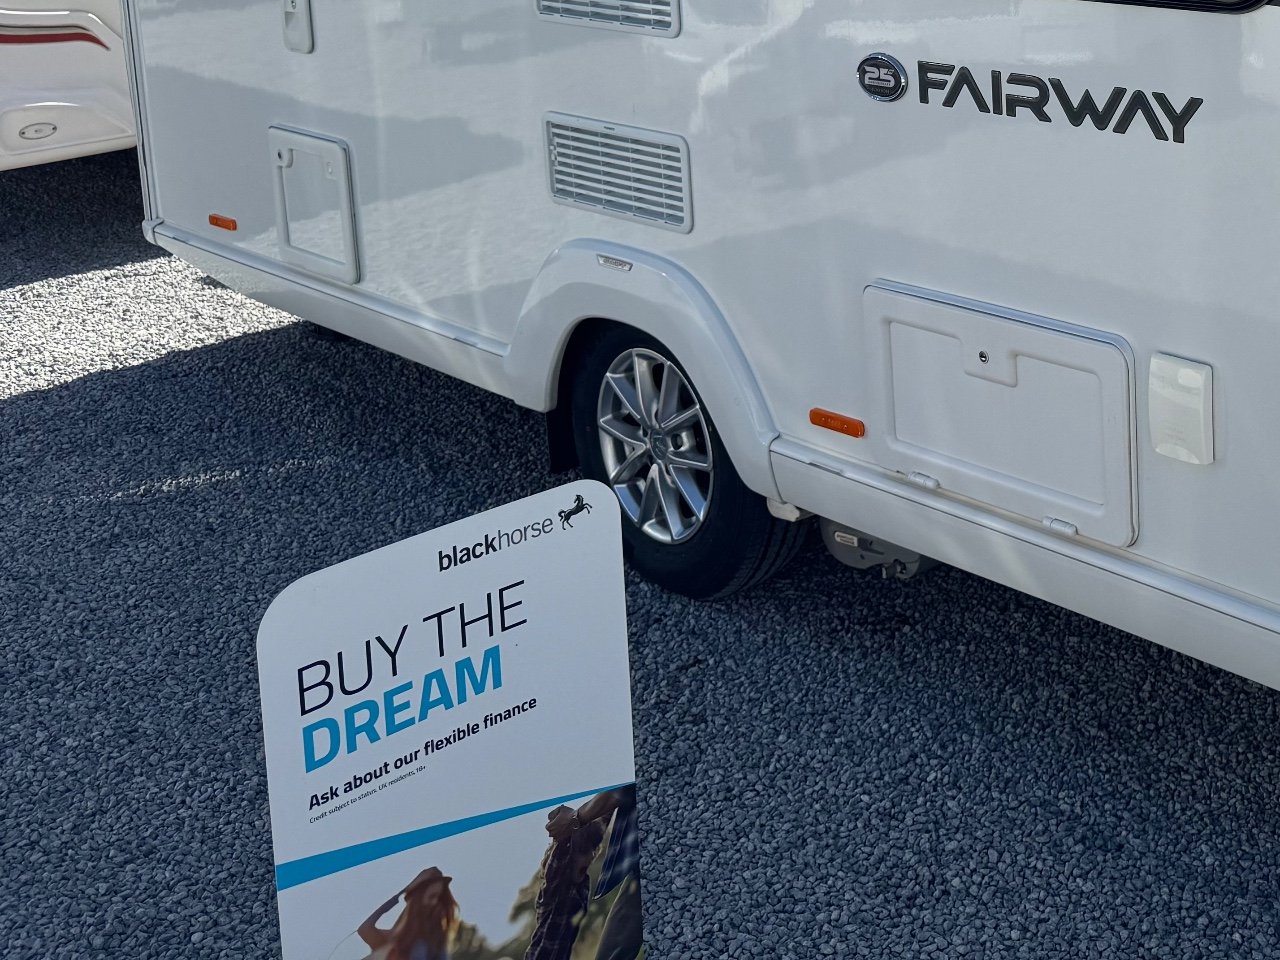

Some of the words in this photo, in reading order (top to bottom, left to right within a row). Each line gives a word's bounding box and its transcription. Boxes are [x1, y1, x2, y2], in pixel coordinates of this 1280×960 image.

[917, 60, 1204, 144] FAIRWAY
[438, 517, 554, 572] blackhorse
[297, 624, 408, 716] BUY
[422, 579, 527, 657] THE
[302, 644, 503, 774] DREAM
[308, 785, 340, 811] Ask
[343, 761, 391, 794] about
[393, 747, 421, 770] our
[424, 722, 480, 757] flexible
[483, 698, 538, 730] finance
[309, 811, 328, 824] Credit
[328, 801, 351, 815] subject
[350, 796, 358, 805] to
[378, 783, 388, 791] UK
